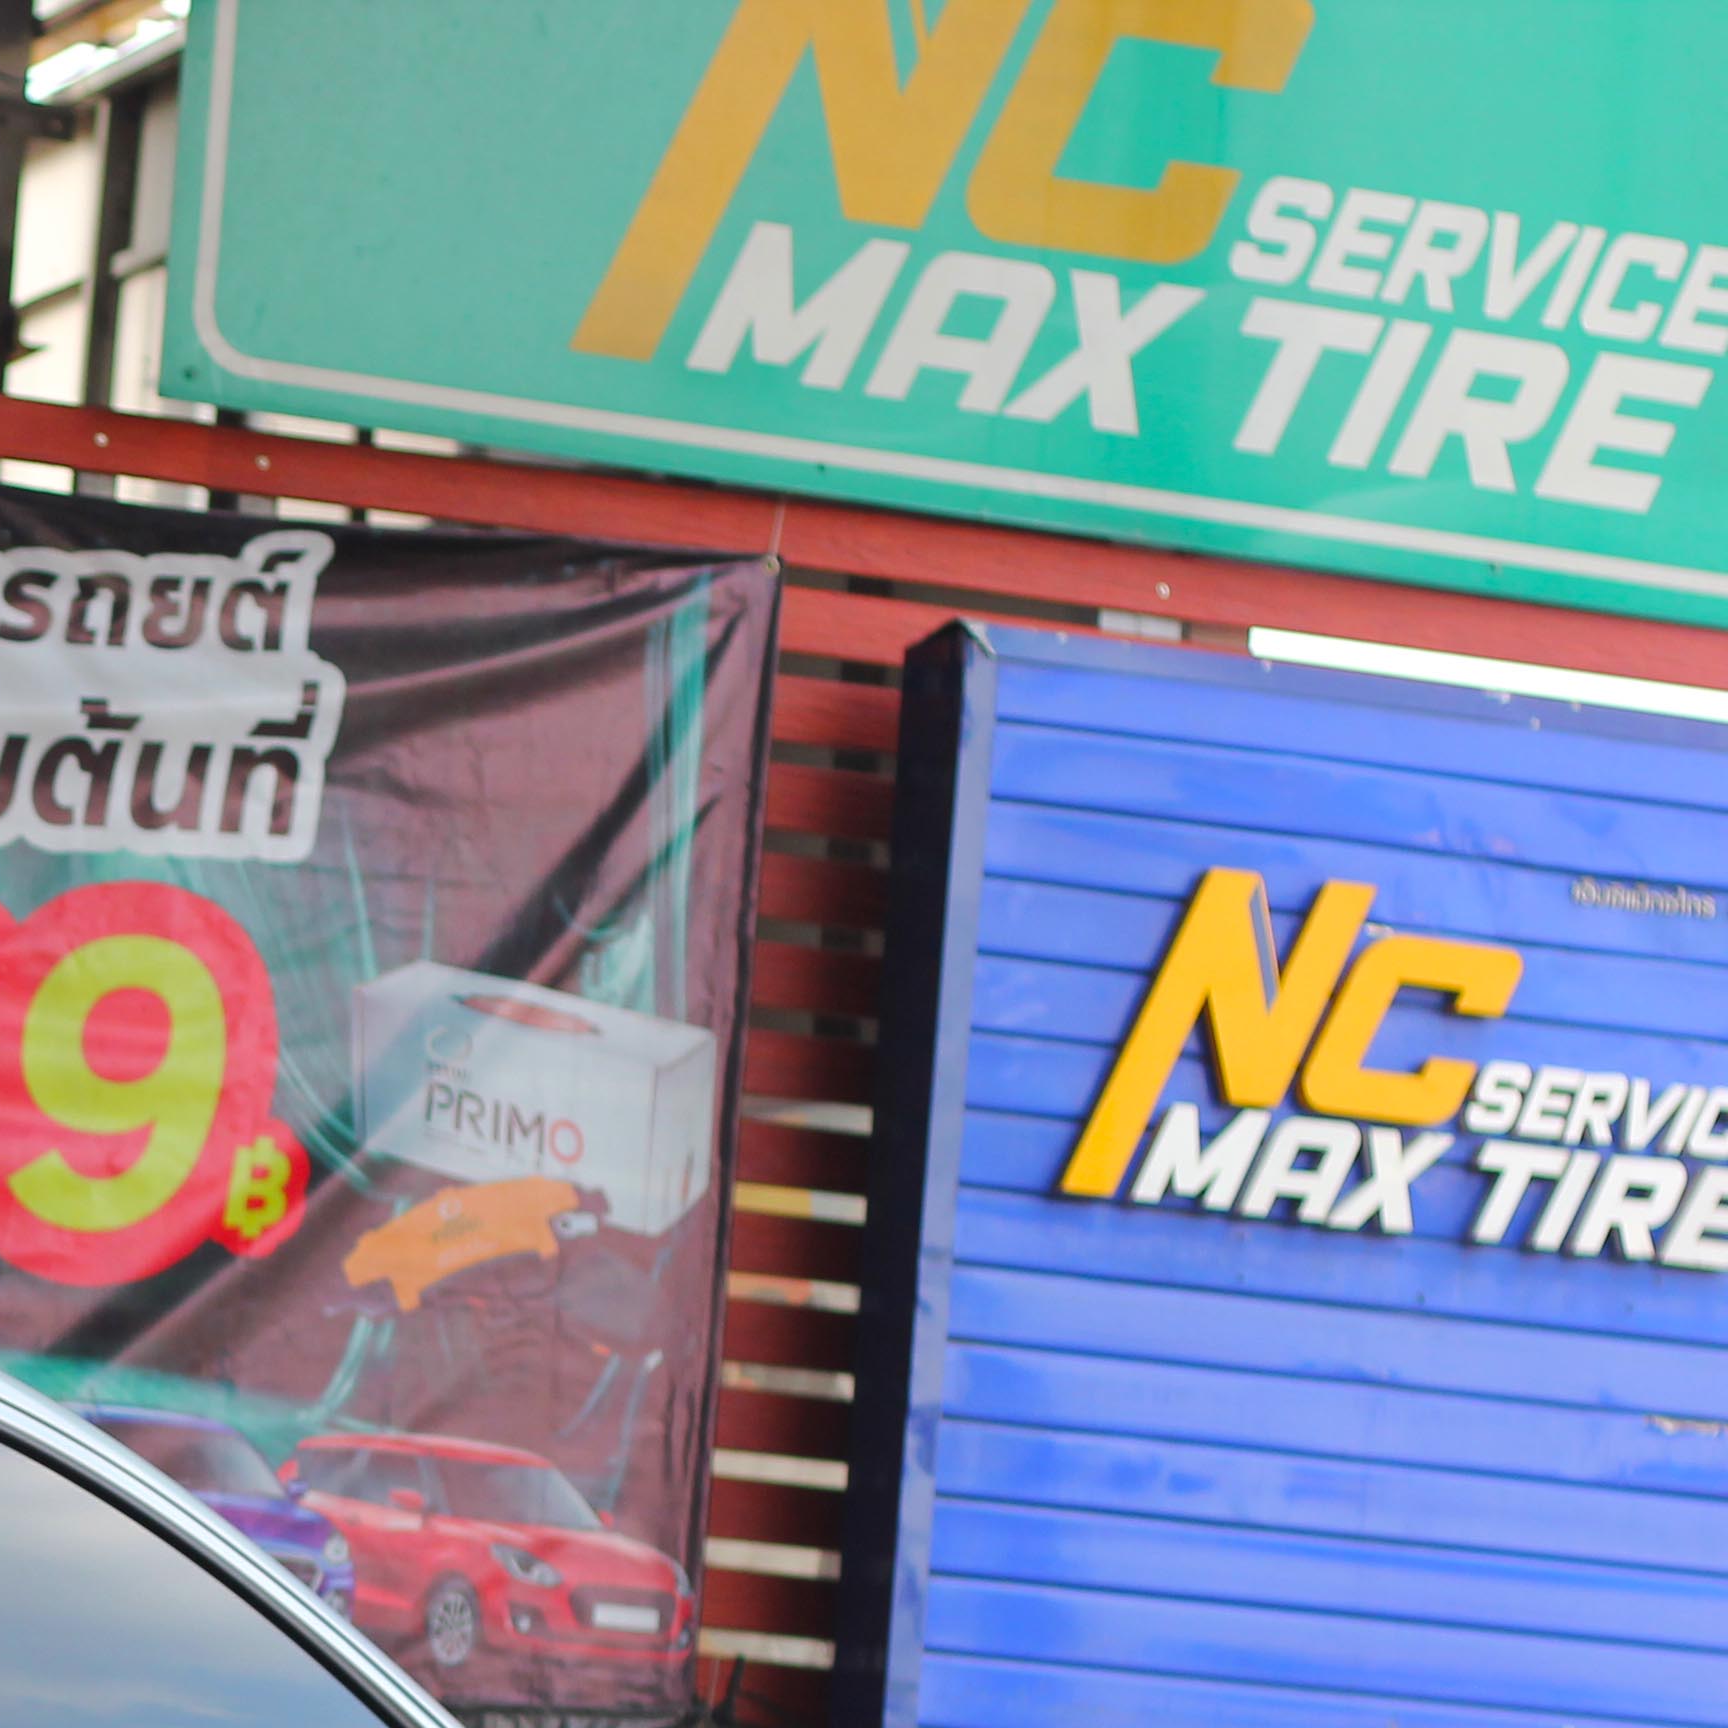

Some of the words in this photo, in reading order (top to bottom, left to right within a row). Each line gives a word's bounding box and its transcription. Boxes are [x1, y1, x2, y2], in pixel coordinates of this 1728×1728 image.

[569, 0, 1314, 363] NC
[686, 221, 1207, 437] MAX
[1232, 297, 1714, 514] TIRE
[424, 1081, 586, 1168] PRIMO
[1059, 866, 1524, 1198] NC
[1130, 1101, 1456, 1236] MAX
[1470, 1140, 1728, 1273] TIRE
